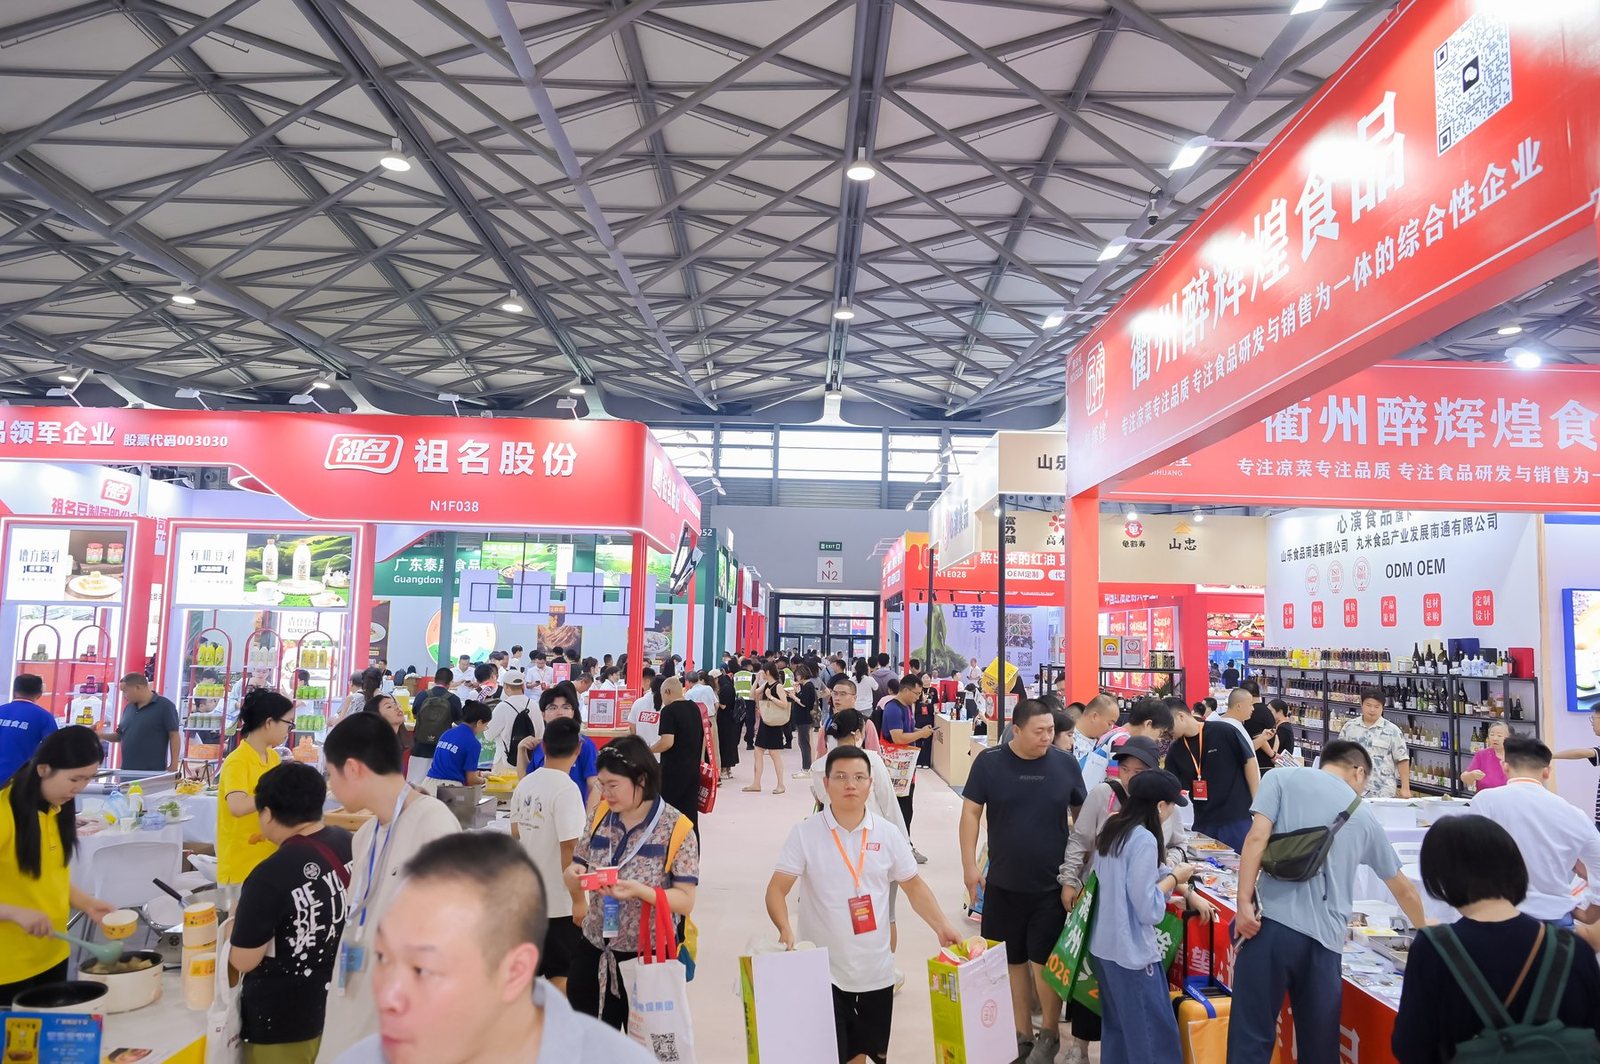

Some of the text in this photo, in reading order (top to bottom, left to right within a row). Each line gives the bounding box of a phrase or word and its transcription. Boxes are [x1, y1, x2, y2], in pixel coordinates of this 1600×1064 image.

[1192, 136, 1544, 394] 专注食品研发与销售为一体的综合性企业
[0, 420, 117, 446] 领军企业
[123, 433, 229, 447] 股票代码003030
[336, 438, 389, 464] 祖名
[414, 438, 578, 476] 祖名股份
[1237, 458, 1391, 481] 专注凉菜专注品质
[430, 500, 479, 513] N1F038
[1169, 537, 1197, 551] 山忠
[1281, 513, 1498, 563] 山乐食品南通有限公司 丸米食品产业发展南通有限公司
[821, 571, 838, 581] N2
[1007, 570, 1039, 579] OEM定制
[1386, 558, 1446, 579] ODM OEM
[393, 574, 443, 586] Guangdon
[1046, 952, 1071, 987] 026
